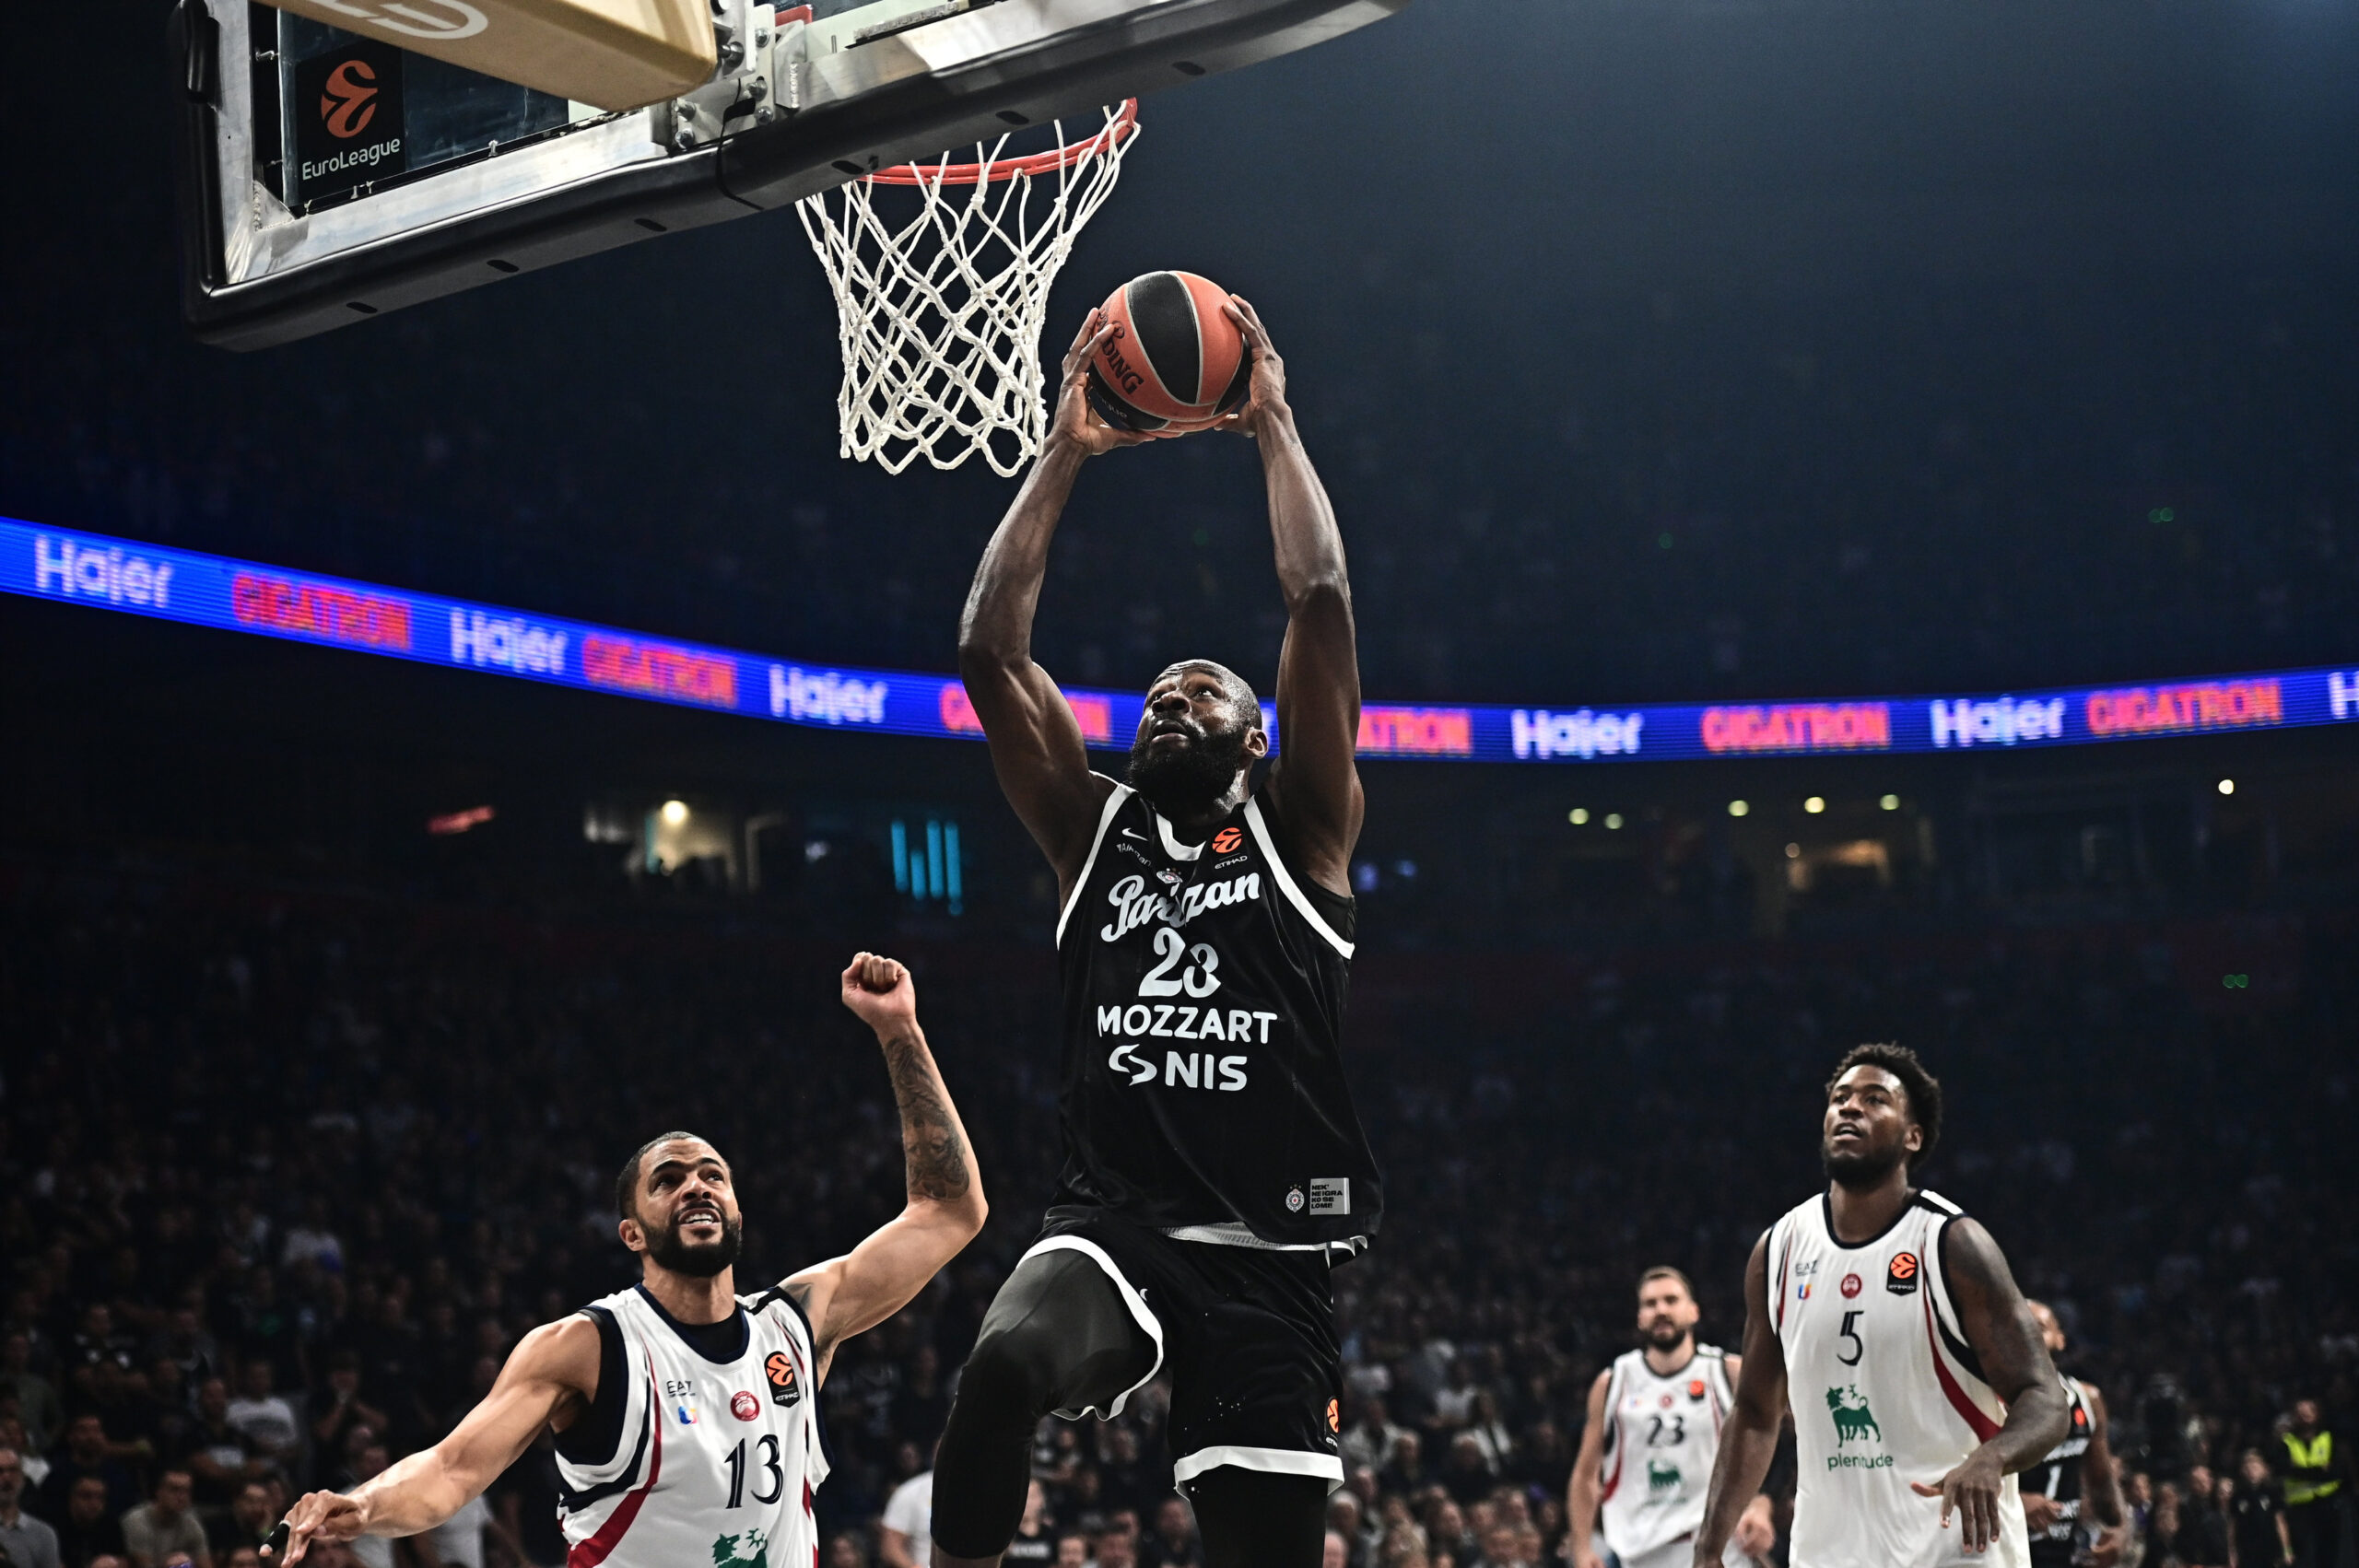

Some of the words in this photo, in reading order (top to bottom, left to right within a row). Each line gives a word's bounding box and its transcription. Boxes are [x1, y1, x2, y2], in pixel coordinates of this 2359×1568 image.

[301, 137, 401, 181] EuroLeague
[34, 533, 173, 609] Haier
[449, 606, 569, 675] Haier
[768, 661, 888, 725] Haier
[1510, 706, 1645, 760] Haier
[1930, 694, 2066, 748] Haier
[1214, 855, 1249, 870] ETIHAD
[1138, 927, 1222, 999] 23
[1097, 1004, 1279, 1045] MOZZART
[1165, 1050, 1248, 1092] NIS
[1837, 1310, 1864, 1367] 5
[1646, 1414, 1685, 1447] 23
[723, 1433, 783, 1509] 13
[1826, 1453, 1894, 1471] plenitude
